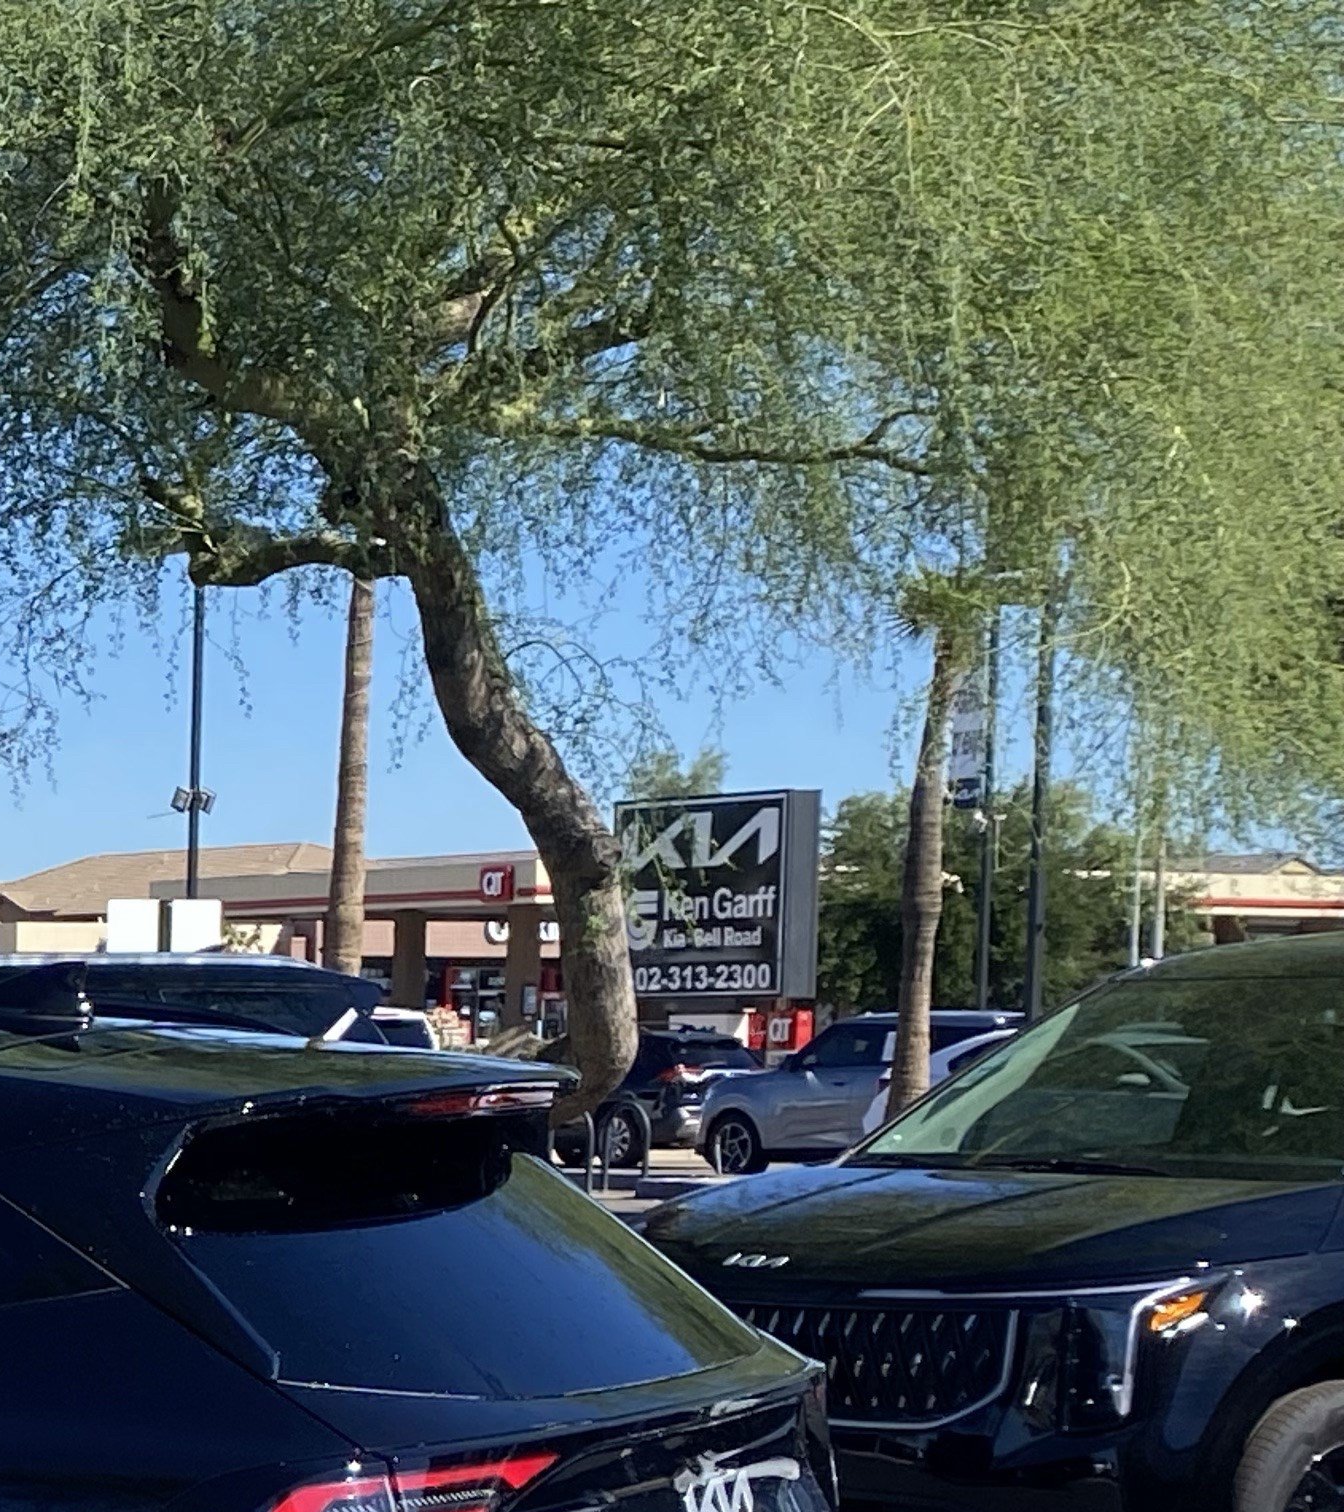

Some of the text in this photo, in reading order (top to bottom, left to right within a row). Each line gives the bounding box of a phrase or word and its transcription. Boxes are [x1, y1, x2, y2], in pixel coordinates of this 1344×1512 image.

[623, 807, 780, 869] KIA
[663, 885, 776, 921] Ken Garff
[724, 925, 762, 946] Road
[635, 963, 771, 991] 02-313-2300
[722, 1252, 790, 1269] KIA
